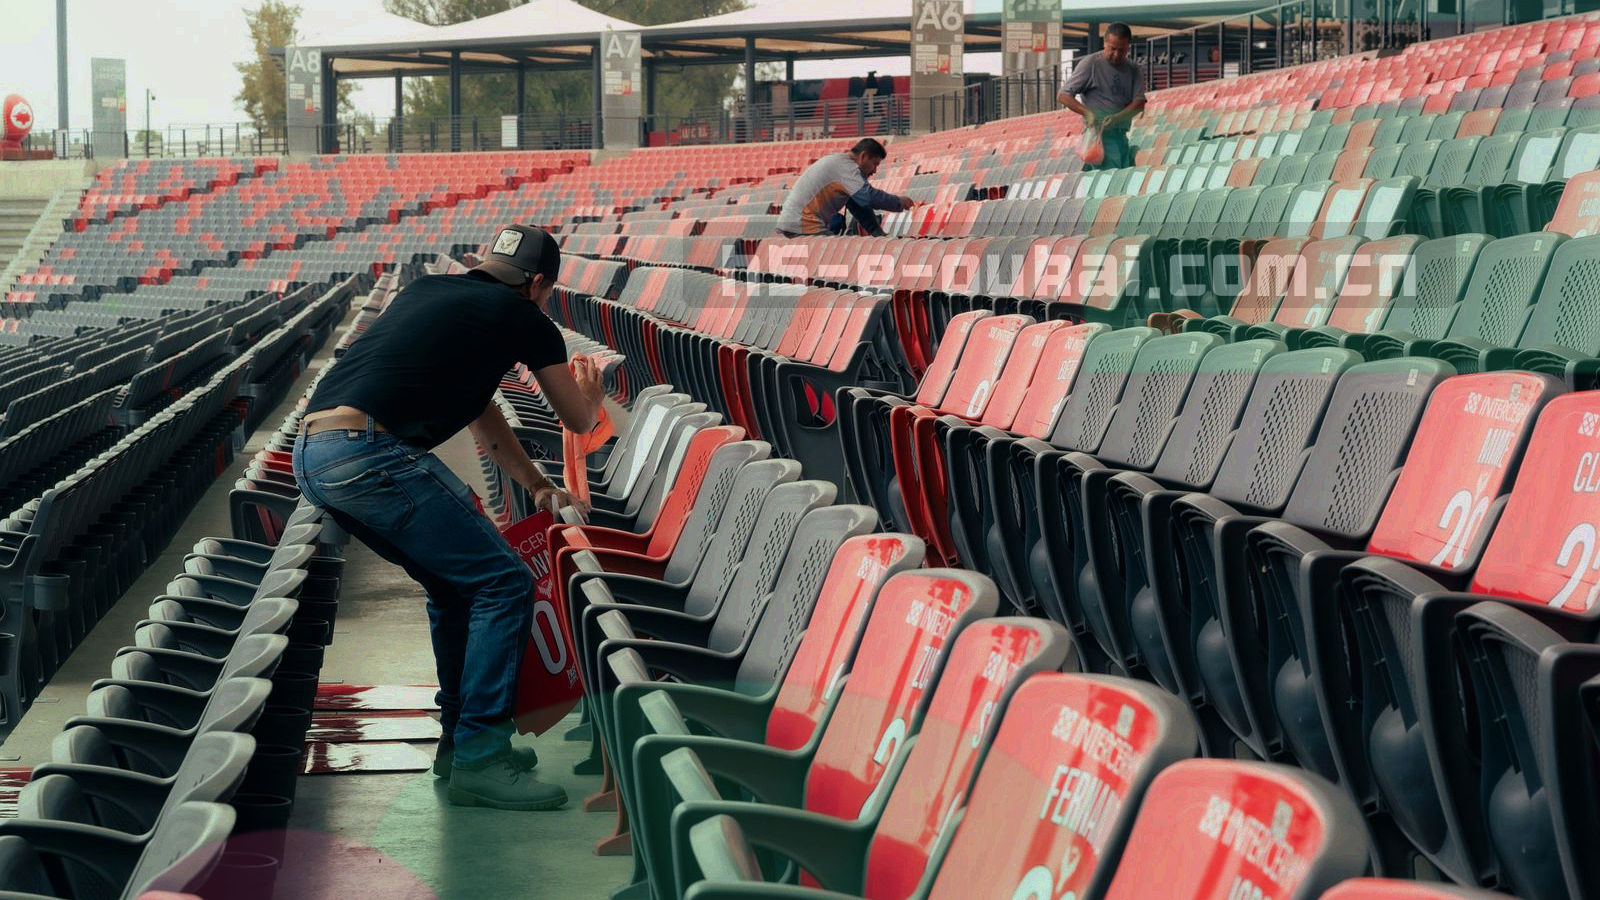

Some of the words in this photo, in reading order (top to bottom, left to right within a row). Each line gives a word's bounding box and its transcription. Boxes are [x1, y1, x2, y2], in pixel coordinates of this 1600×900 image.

[916, 1, 963, 31] A6
[606, 34, 639, 58] A7
[290, 50, 320, 73] A8
